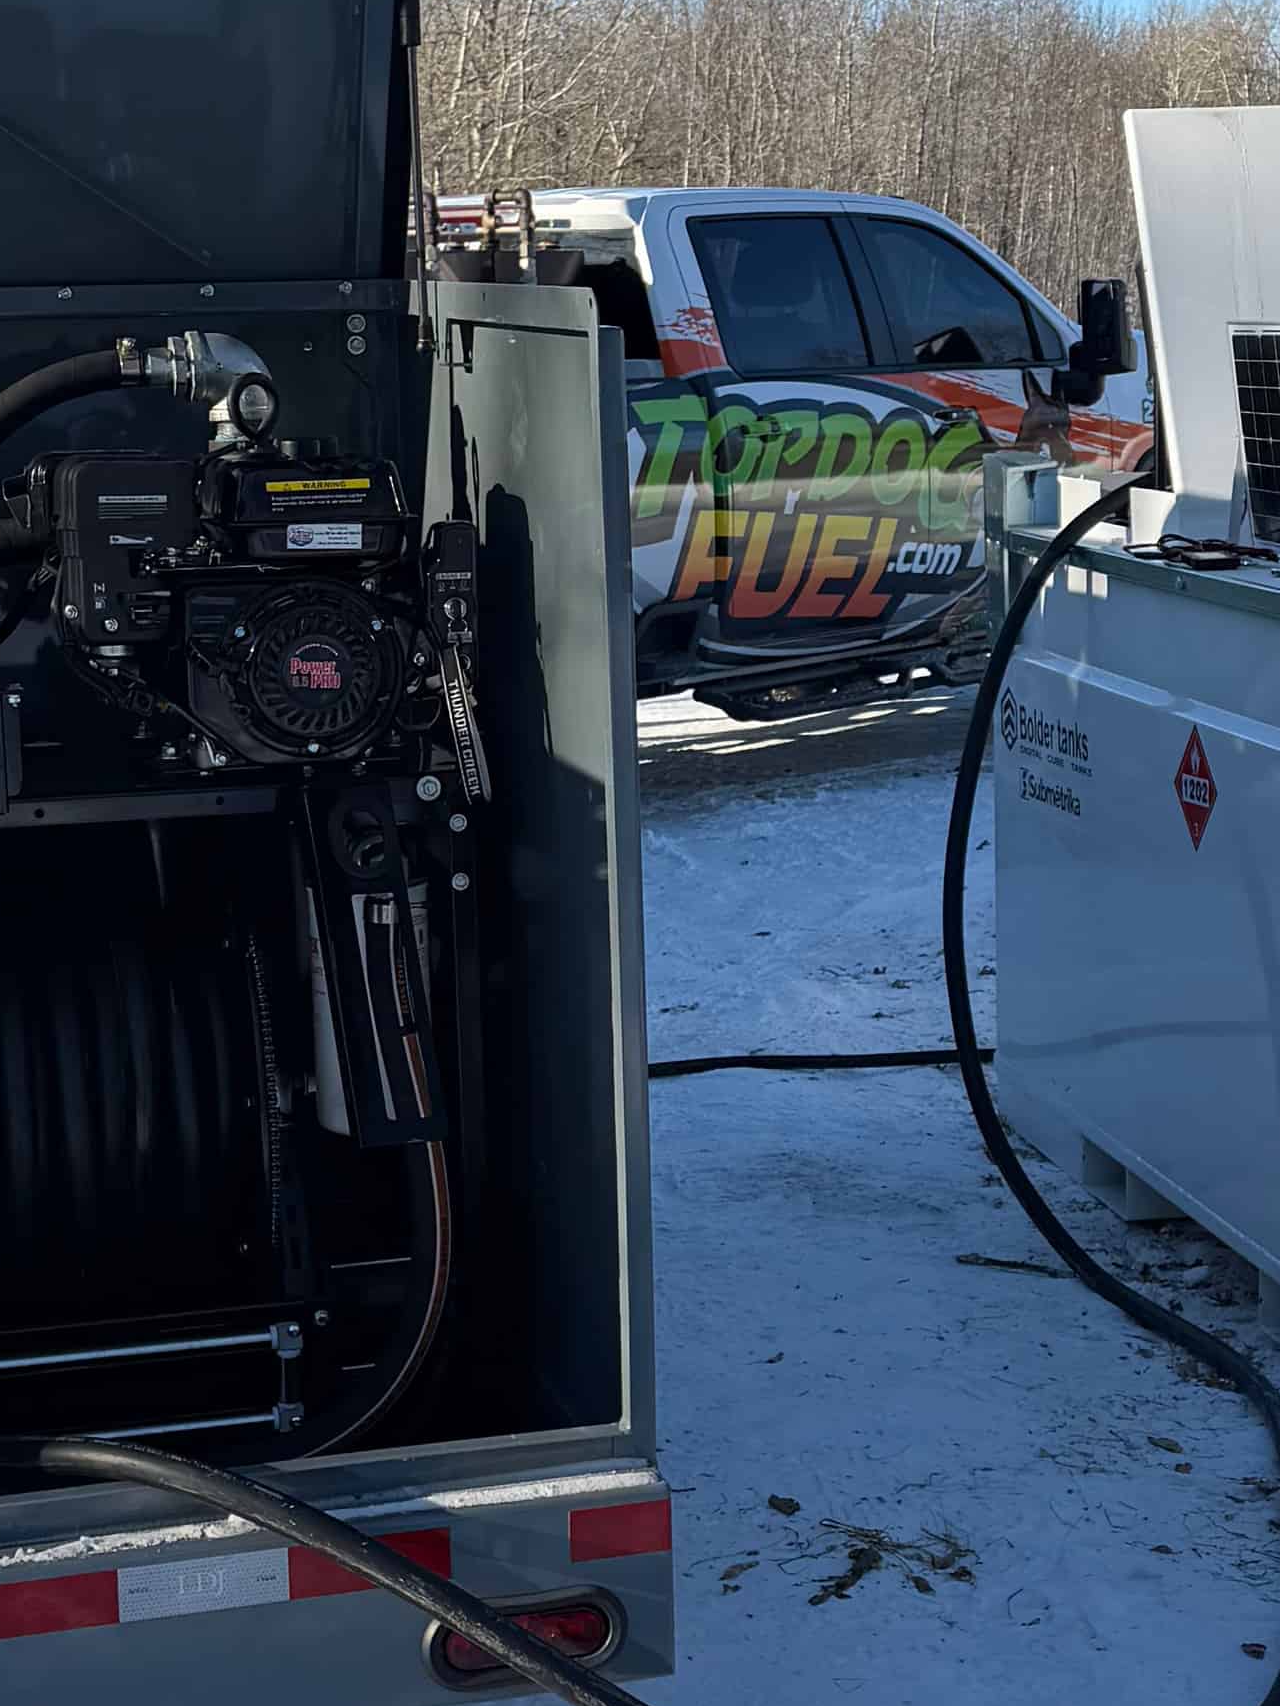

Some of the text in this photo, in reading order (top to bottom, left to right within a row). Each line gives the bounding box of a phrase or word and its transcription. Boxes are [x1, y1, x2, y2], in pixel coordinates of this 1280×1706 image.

[447, 678, 472, 746] THUNDER
[1020, 705, 1089, 761] Bolder tanks
[1184, 778, 1208, 804] 1202
